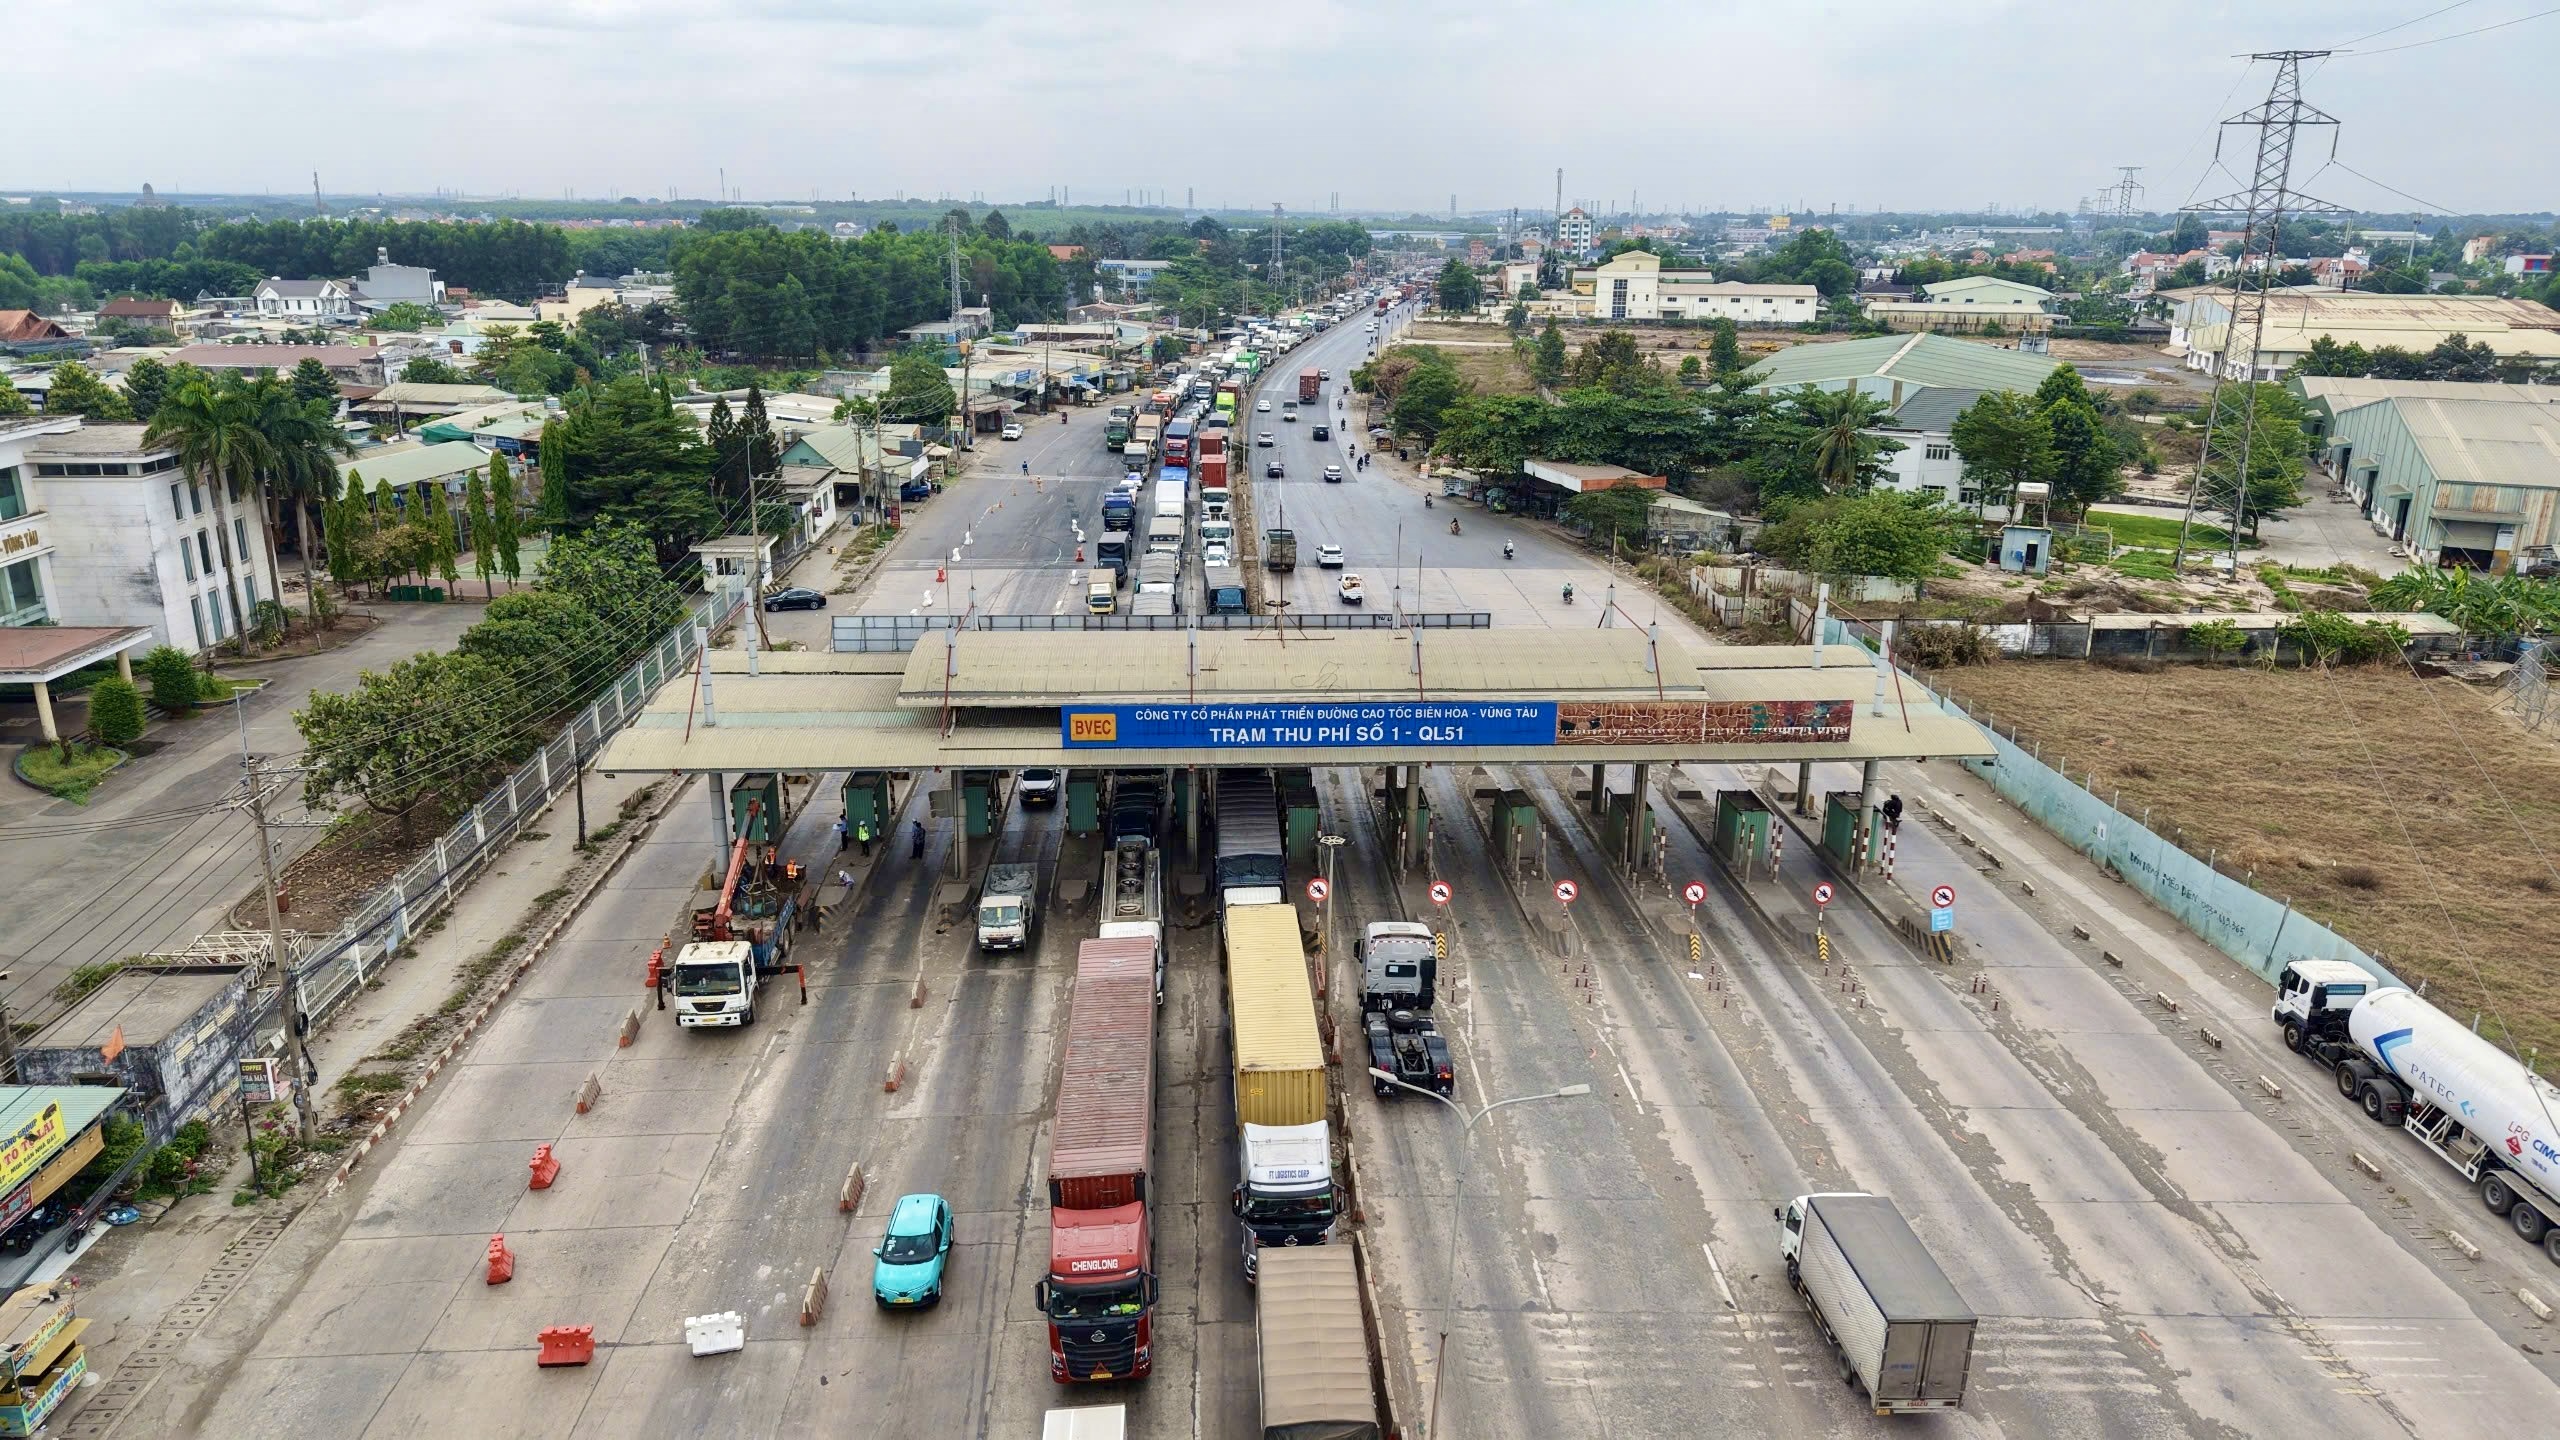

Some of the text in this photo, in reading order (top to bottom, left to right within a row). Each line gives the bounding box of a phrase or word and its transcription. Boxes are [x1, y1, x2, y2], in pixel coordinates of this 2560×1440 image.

[1135, 707, 1169, 721] CÔNG
[1174, 710, 1187, 720] TY
[1191, 706, 1208, 721] CỔ
[1211, 707, 1243, 720] PHẦN
[1245, 707, 1277, 720] PHÁT
[1281, 706, 1314, 720] TRIỂN
[1317, 706, 1358, 719] ĐƯỜNG
[1361, 708, 1385, 719] CAO
[1388, 705, 1412, 719] TỐC
[1415, 706, 1442, 719] BIÊN
[1444, 706, 1469, 718] HÒA
[1480, 706, 1512, 718] VŨNG
[1516, 706, 1538, 718] TÀU
[1075, 719, 1112, 735] BVEC
[1209, 728, 1266, 744] TRẠM
[1272, 728, 1311, 742] THU
[1318, 723, 1350, 742] PHÍ
[1356, 721, 1384, 742] SỐ
[1391, 727, 1399, 741] 1
[1418, 726, 1464, 742] QL51
[2410, 1063, 2455, 1102] PATEC
[2508, 1121, 2530, 1142] LPG
[1275, 1170, 1297, 1179] LOGISTICS
[1297, 1169, 1310, 1178] CORP
[1071, 1258, 1118, 1271] CHENGLONG
